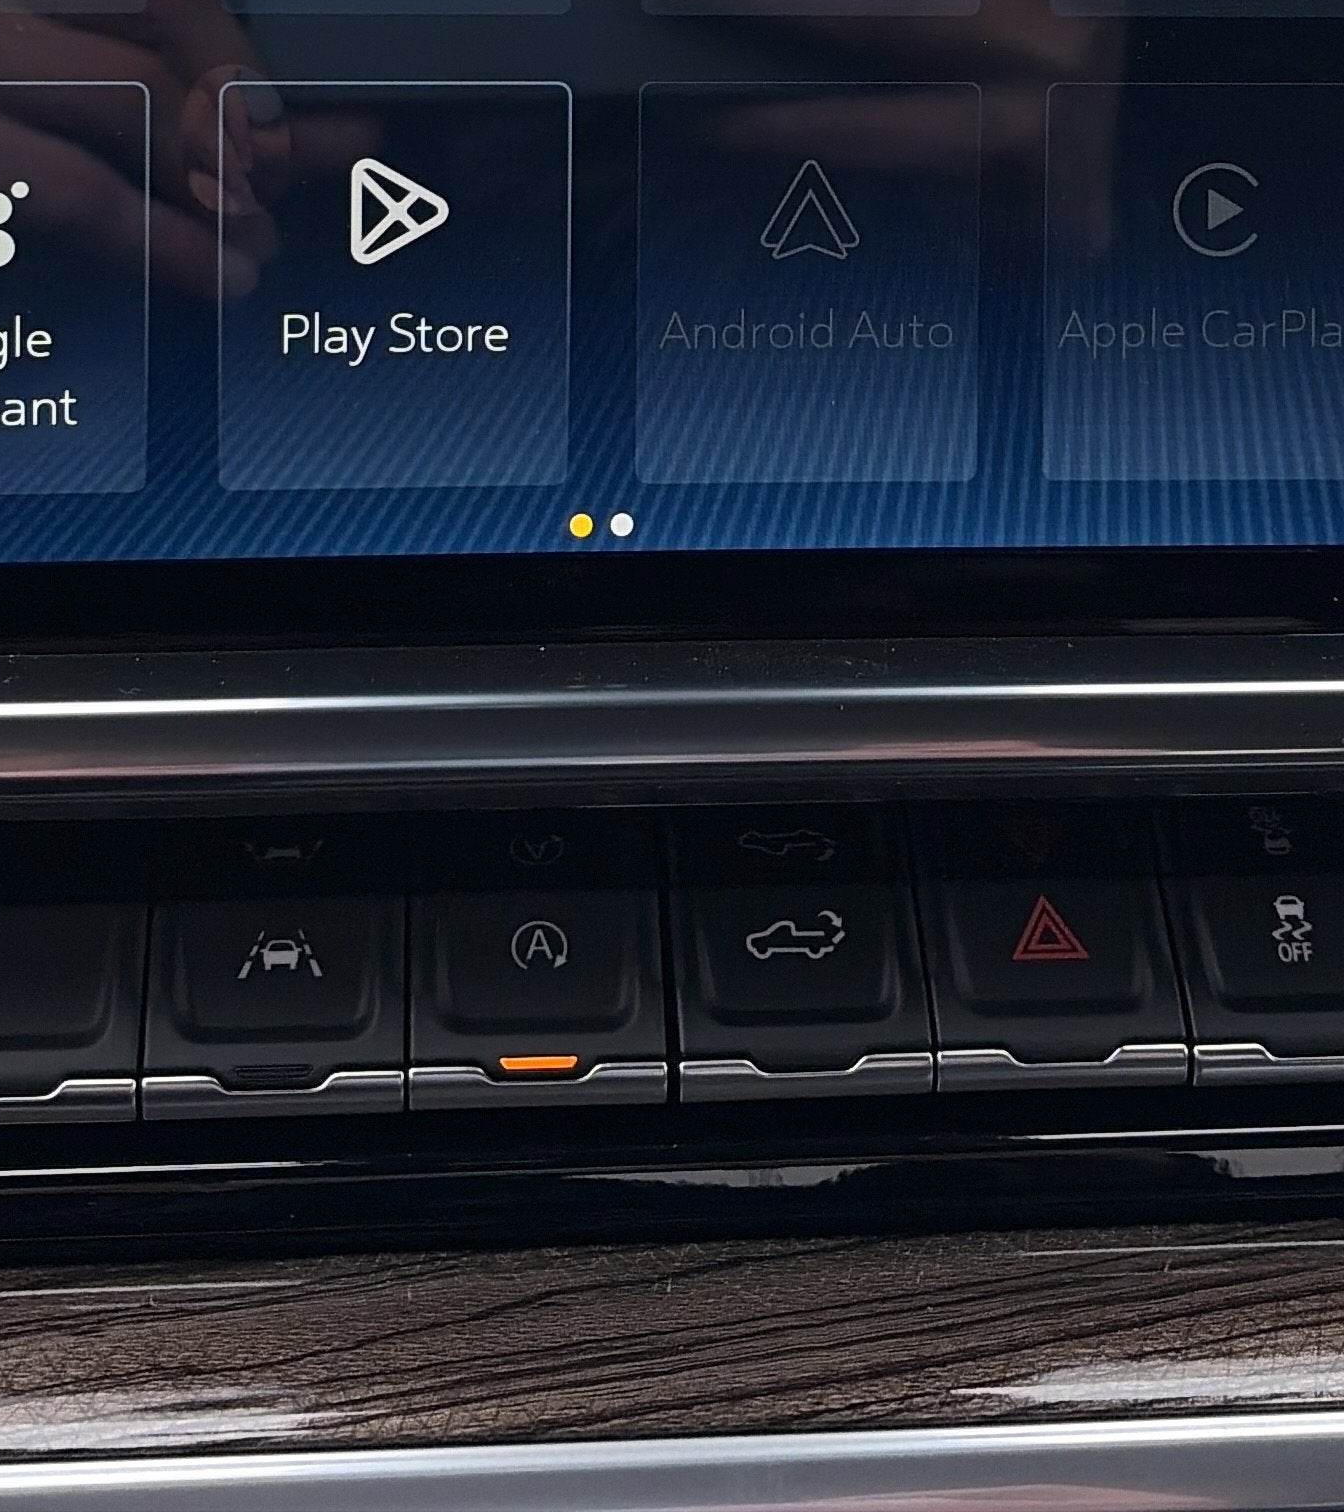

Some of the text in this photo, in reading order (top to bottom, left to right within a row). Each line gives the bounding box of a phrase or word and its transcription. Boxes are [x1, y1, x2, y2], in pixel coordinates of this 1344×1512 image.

[283, 311, 510, 367] Play Store
[658, 307, 955, 351] Android Auto
[1058, 307, 1185, 360] Apple
[1277, 941, 1313, 963] OFF
